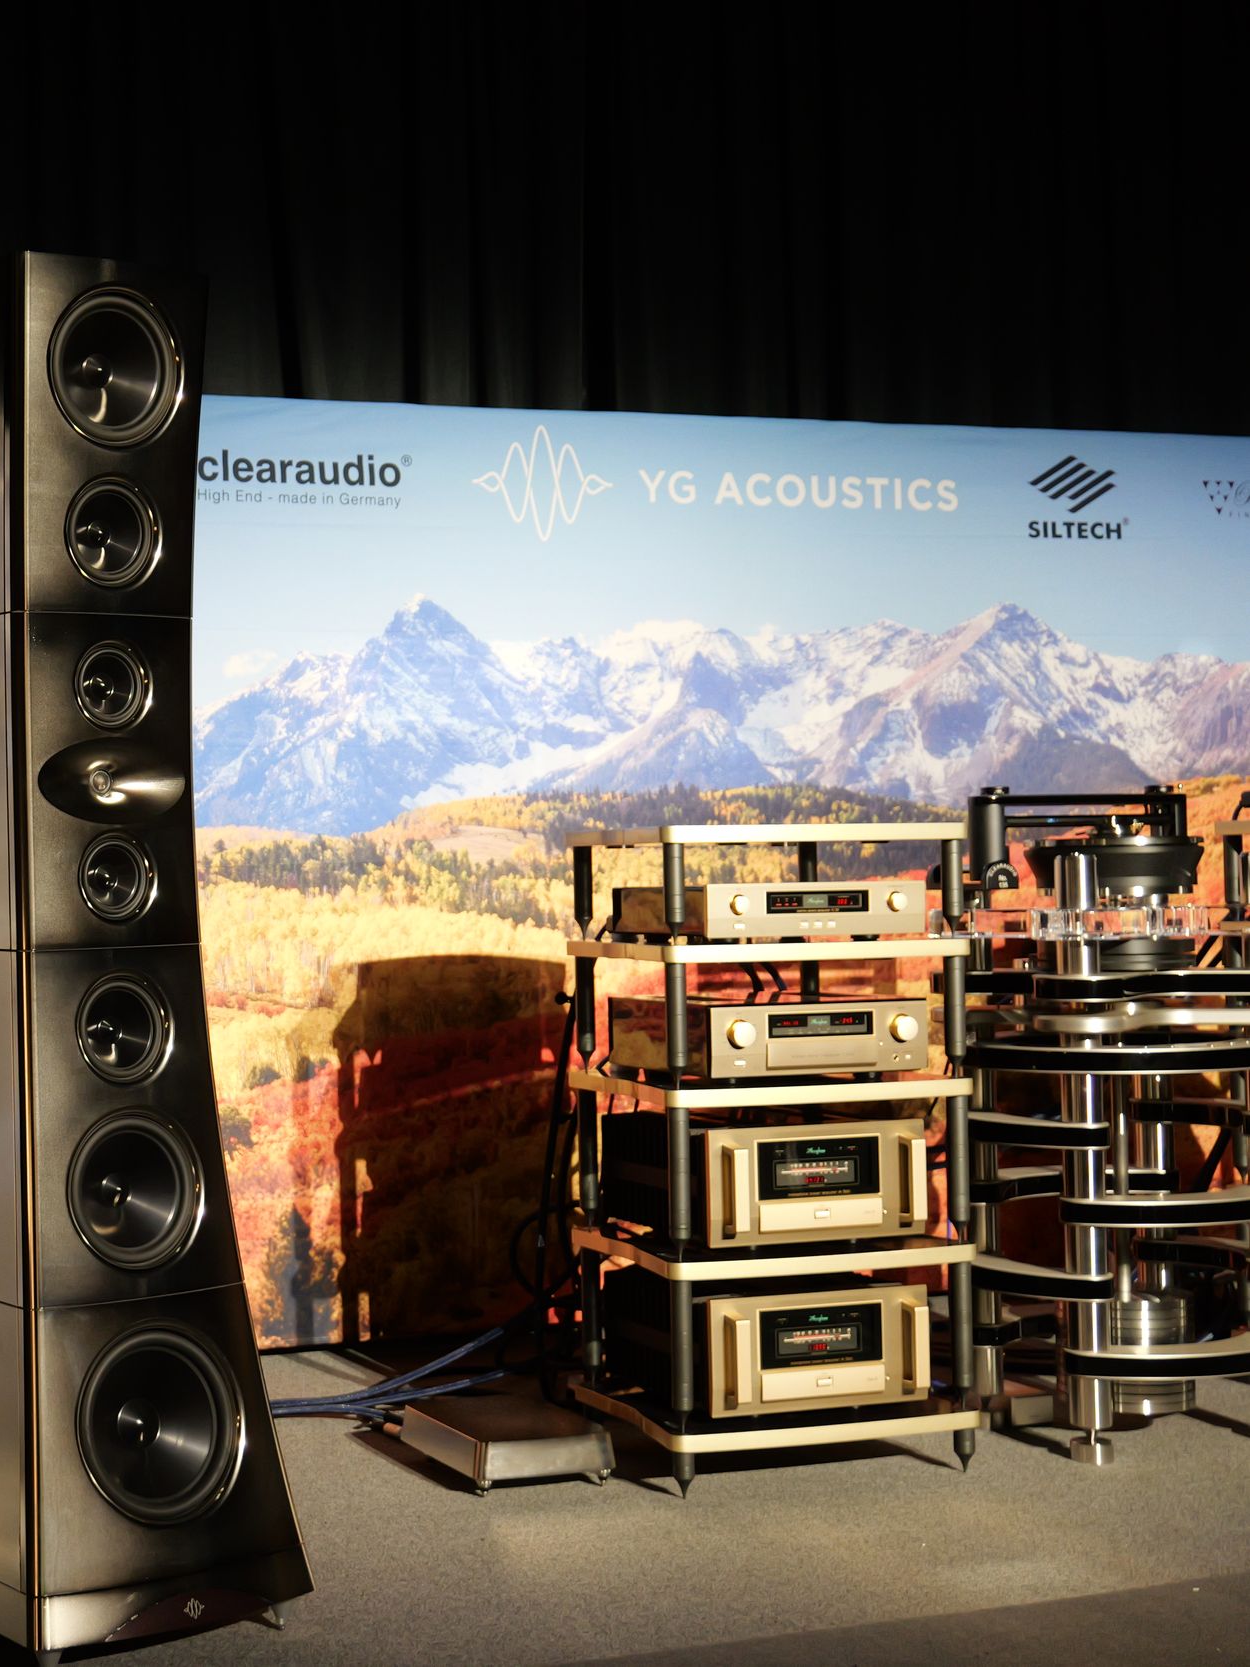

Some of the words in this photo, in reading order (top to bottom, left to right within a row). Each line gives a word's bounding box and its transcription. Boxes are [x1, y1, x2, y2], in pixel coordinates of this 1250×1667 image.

[197, 449, 402, 488] clearaudio
[196, 488, 230, 505] High
[235, 489, 263, 503] End
[278, 491, 318, 505] made
[322, 492, 335, 505] in
[339, 492, 402, 509] Germany
[638, 468, 697, 505] YG
[714, 471, 959, 513] ACOUSTICS
[1027, 520, 1123, 541] SILTECH
